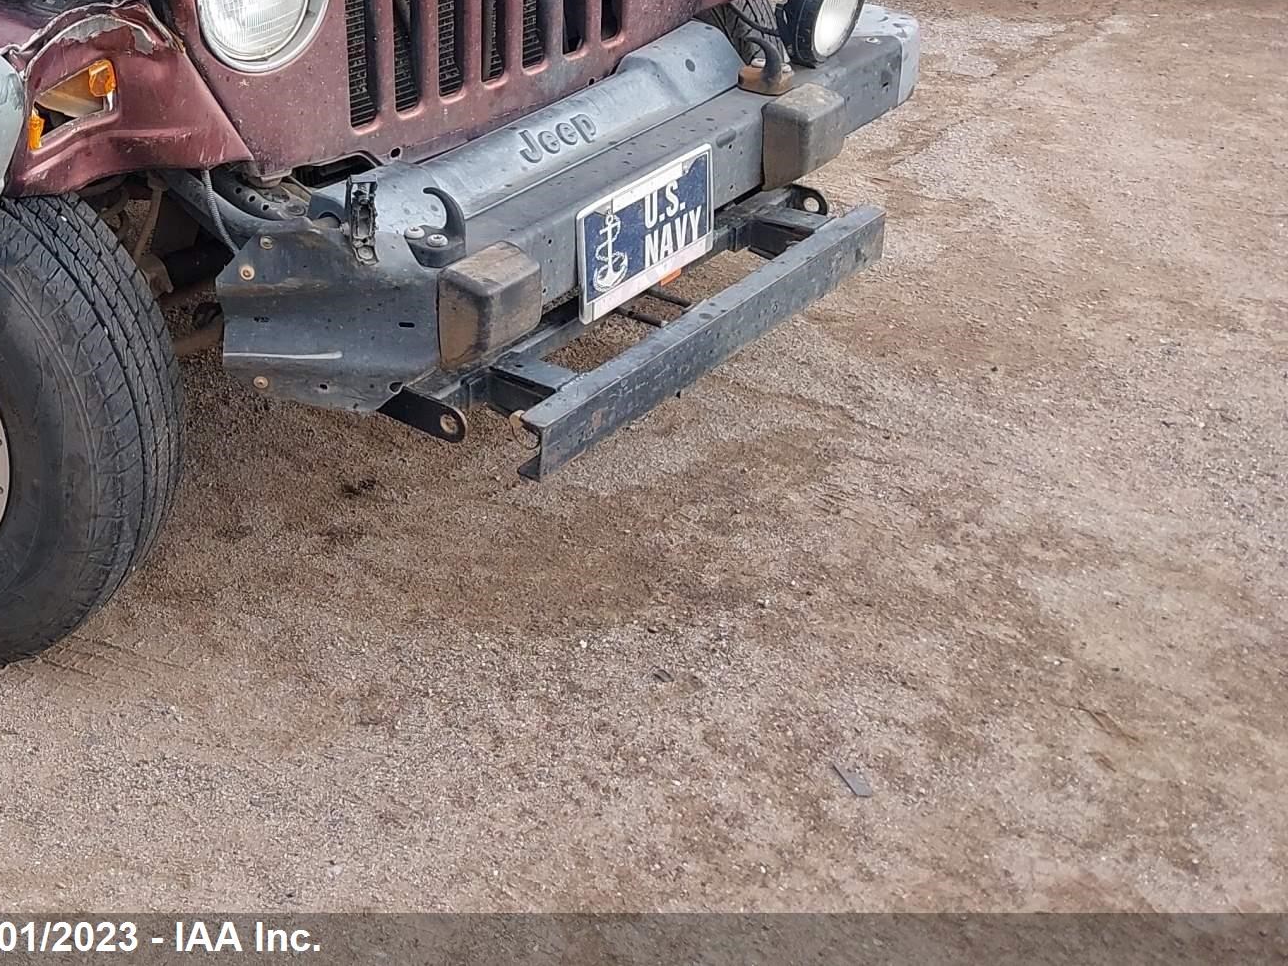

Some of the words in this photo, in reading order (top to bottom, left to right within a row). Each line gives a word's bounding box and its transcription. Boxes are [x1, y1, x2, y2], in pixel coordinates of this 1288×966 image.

[518, 113, 597, 164] Jeep
[644, 180, 686, 229] U.S.
[644, 205, 702, 269] NAVY
